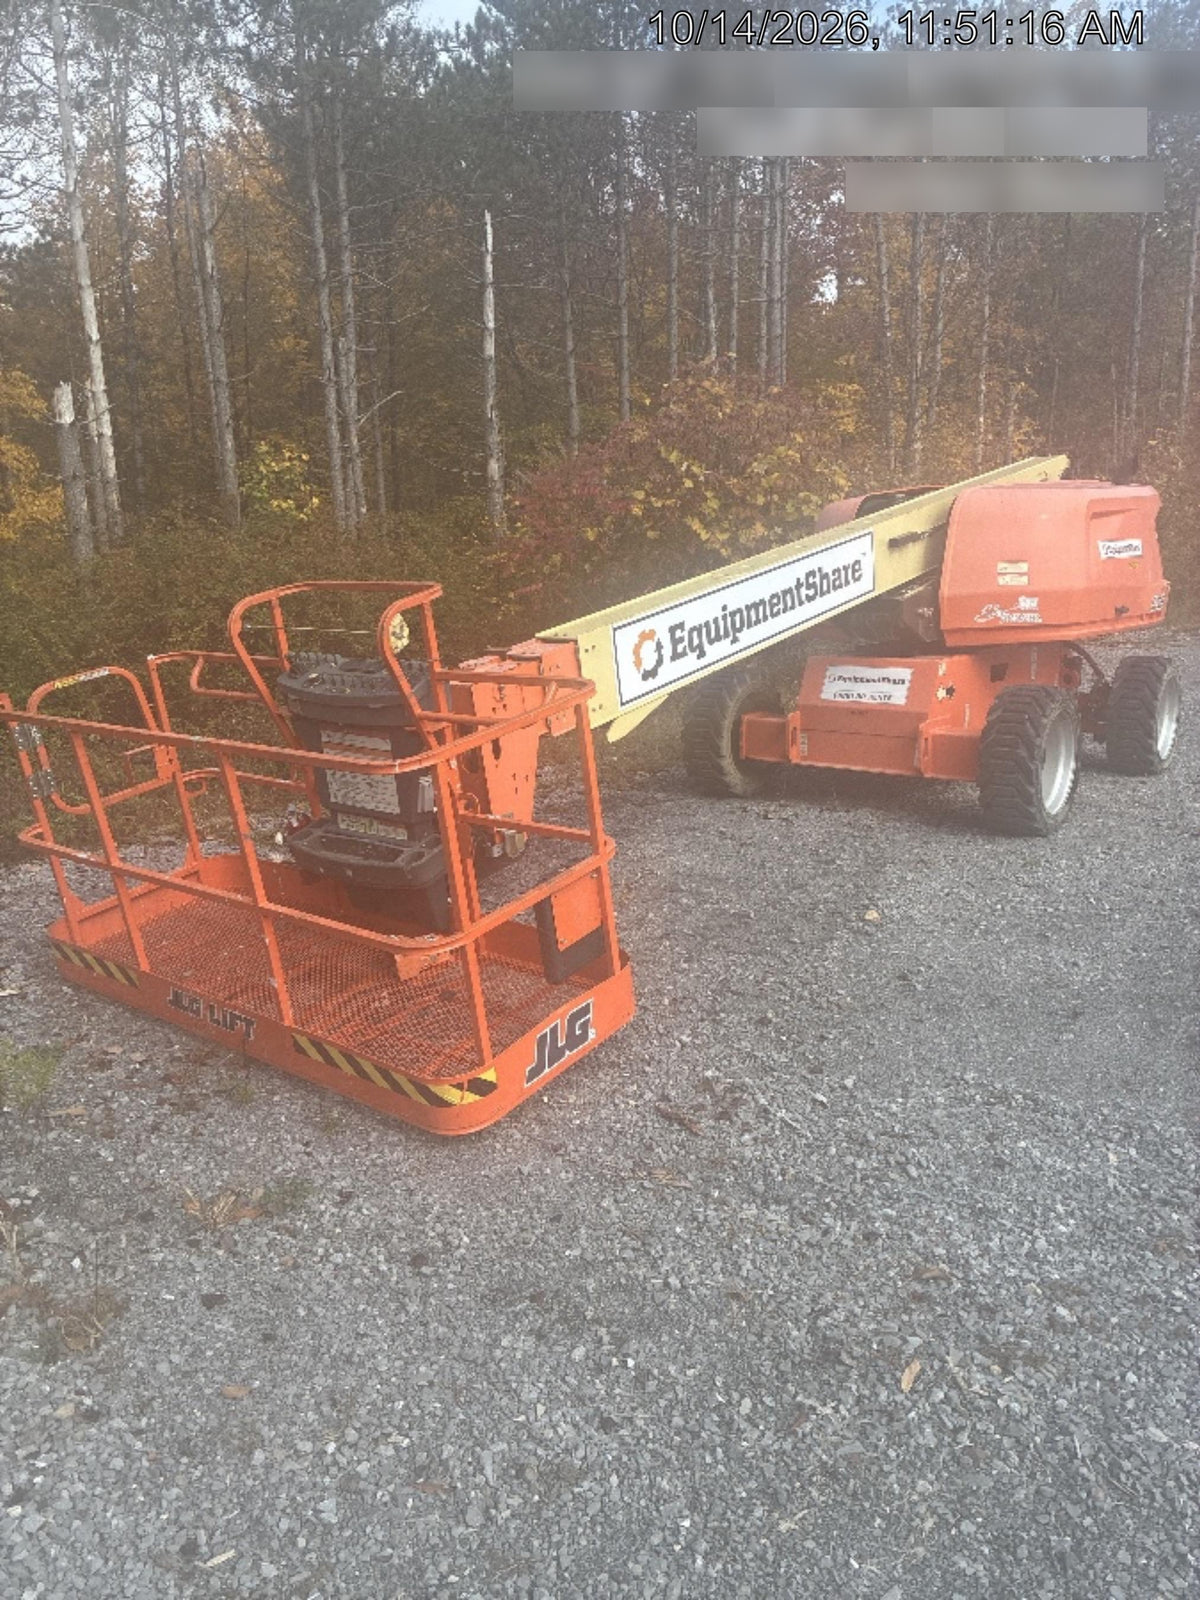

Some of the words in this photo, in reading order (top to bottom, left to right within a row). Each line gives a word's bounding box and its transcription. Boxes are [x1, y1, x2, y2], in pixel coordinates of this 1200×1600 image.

[668, 558, 864, 663] EquipmentShare
[208, 1002, 256, 1040] LIFT
[525, 997, 593, 1088] JLG
